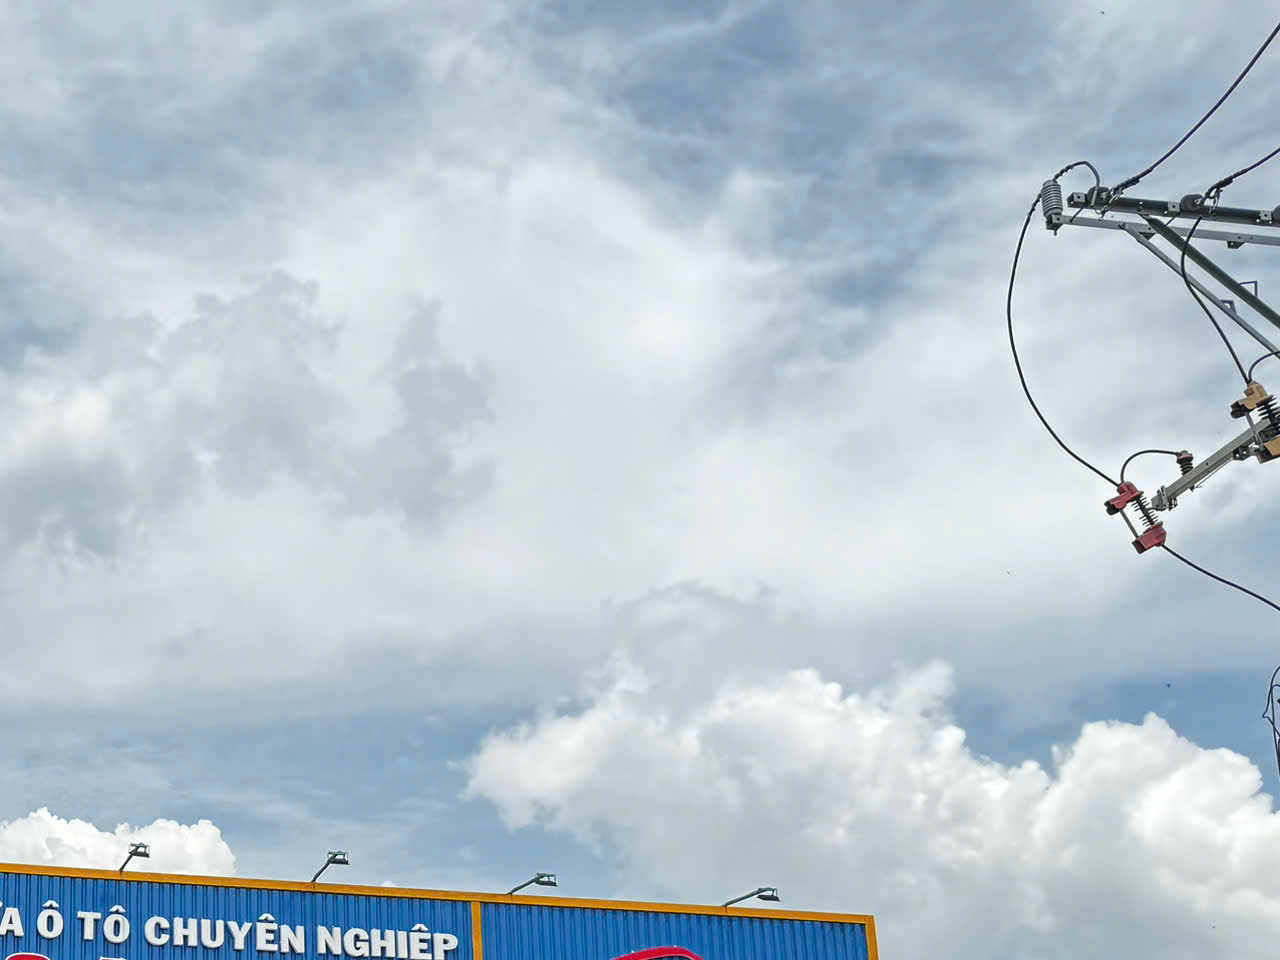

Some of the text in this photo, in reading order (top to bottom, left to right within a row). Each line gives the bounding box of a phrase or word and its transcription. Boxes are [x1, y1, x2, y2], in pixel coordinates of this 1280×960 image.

[37, 900, 64, 939] Ô
[77, 905, 130, 944] TÔ
[145, 913, 305, 954] CHUYÊN
